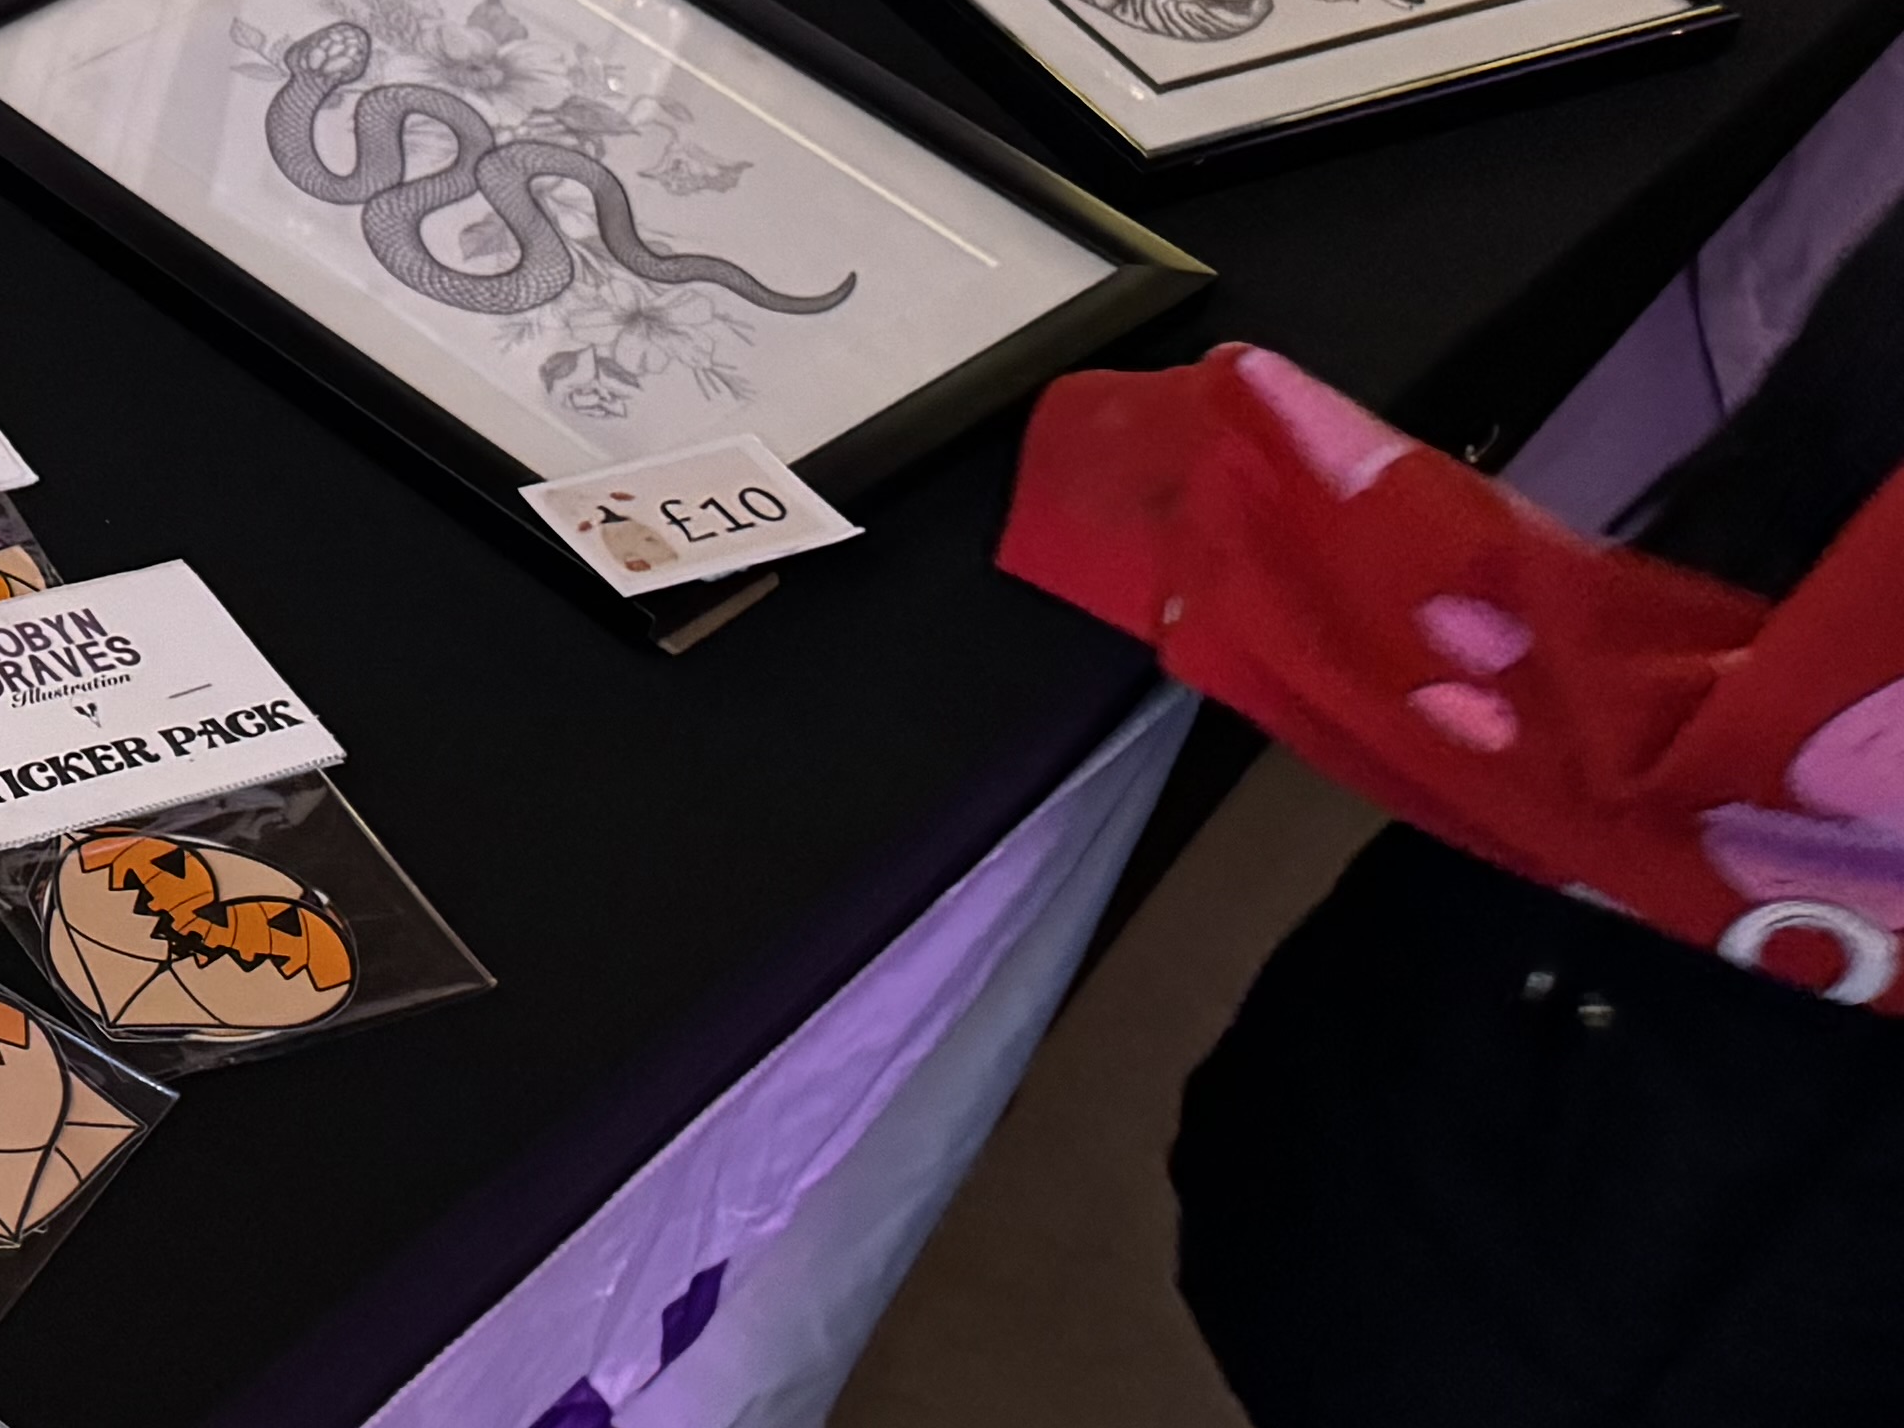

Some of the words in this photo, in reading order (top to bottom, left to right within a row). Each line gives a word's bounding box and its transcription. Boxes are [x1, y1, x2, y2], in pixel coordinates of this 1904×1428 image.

[659, 485, 788, 543] £10
[8, 671, 132, 709] Illustration
[163, 702, 304, 760] PACK
